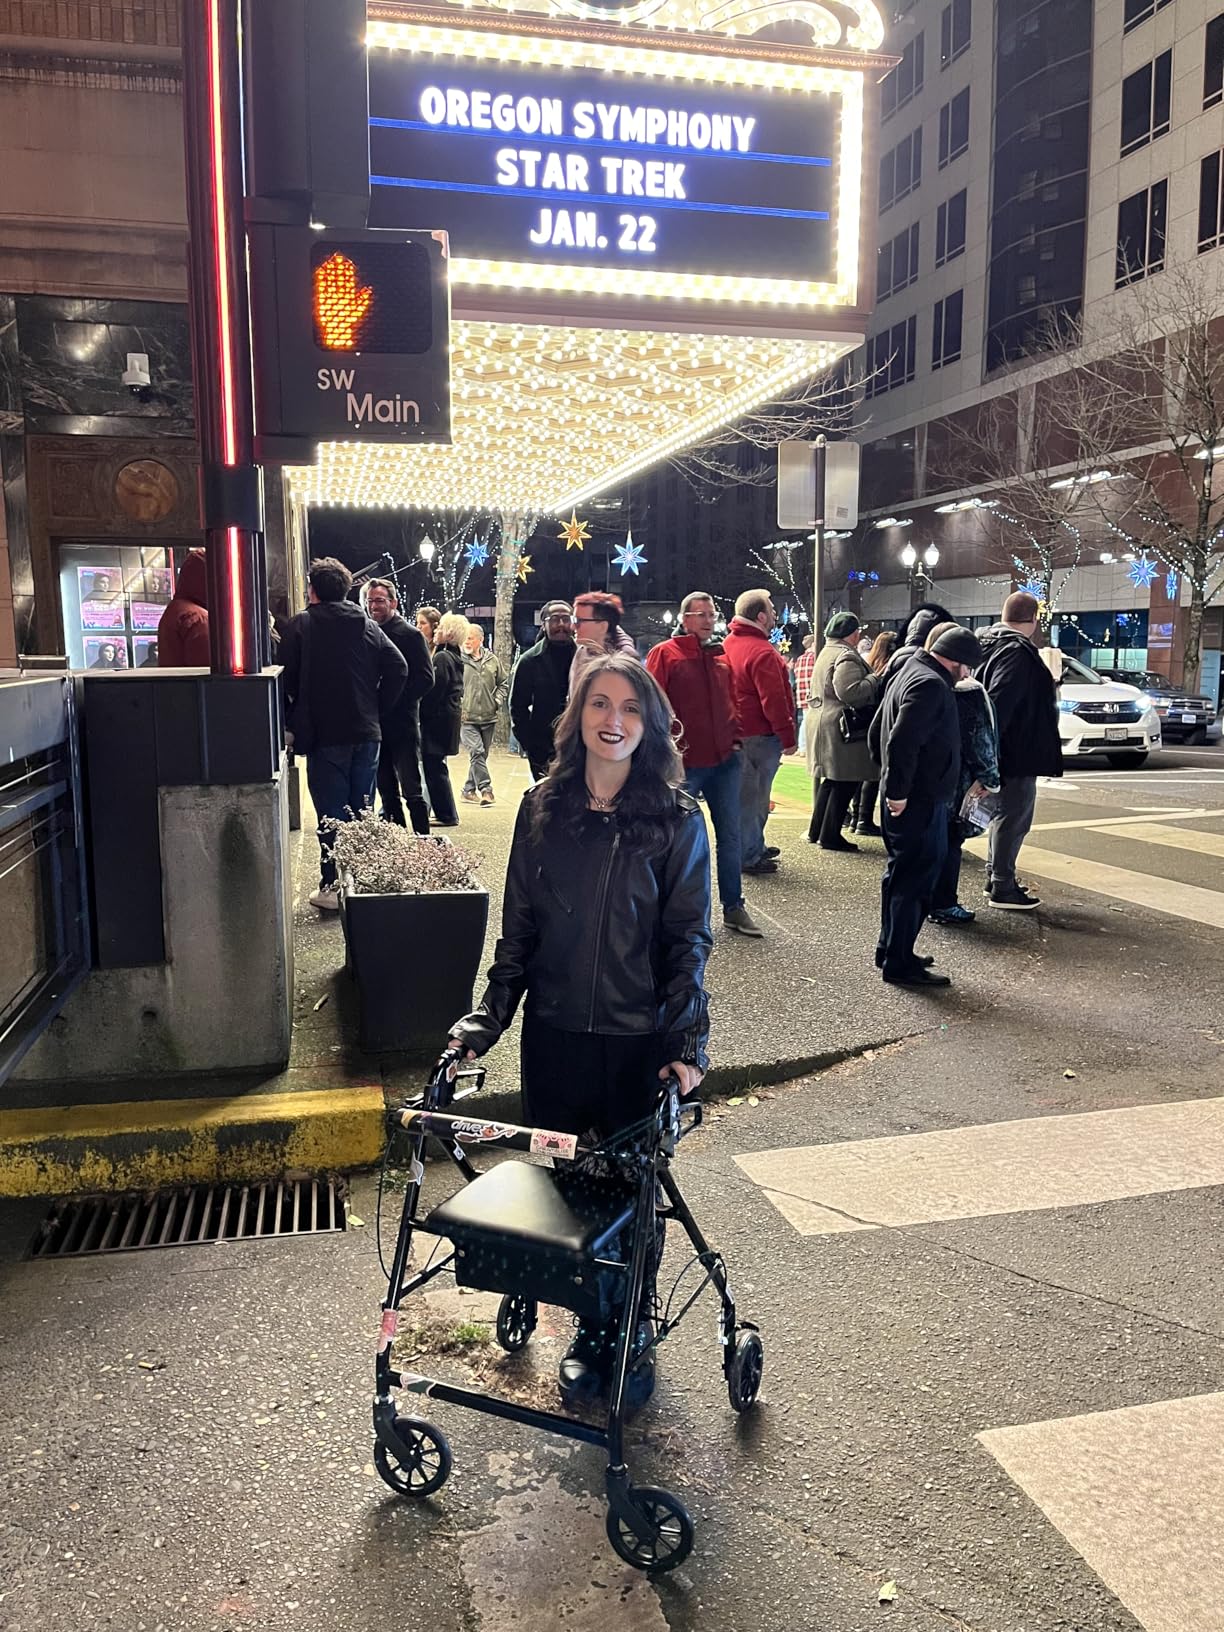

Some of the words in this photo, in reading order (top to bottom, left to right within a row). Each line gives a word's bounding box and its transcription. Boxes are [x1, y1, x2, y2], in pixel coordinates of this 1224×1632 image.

[419, 86, 562, 137] OREGON
[572, 100, 756, 153] SYMPHONY
[496, 147, 589, 191] STAR
[600, 156, 687, 199] TREK
[530, 207, 608, 249] JAN.
[618, 213, 656, 254] 22
[317, 368, 355, 390] SW
[346, 393, 420, 423] Main
[450, 1120, 481, 1132] drive
